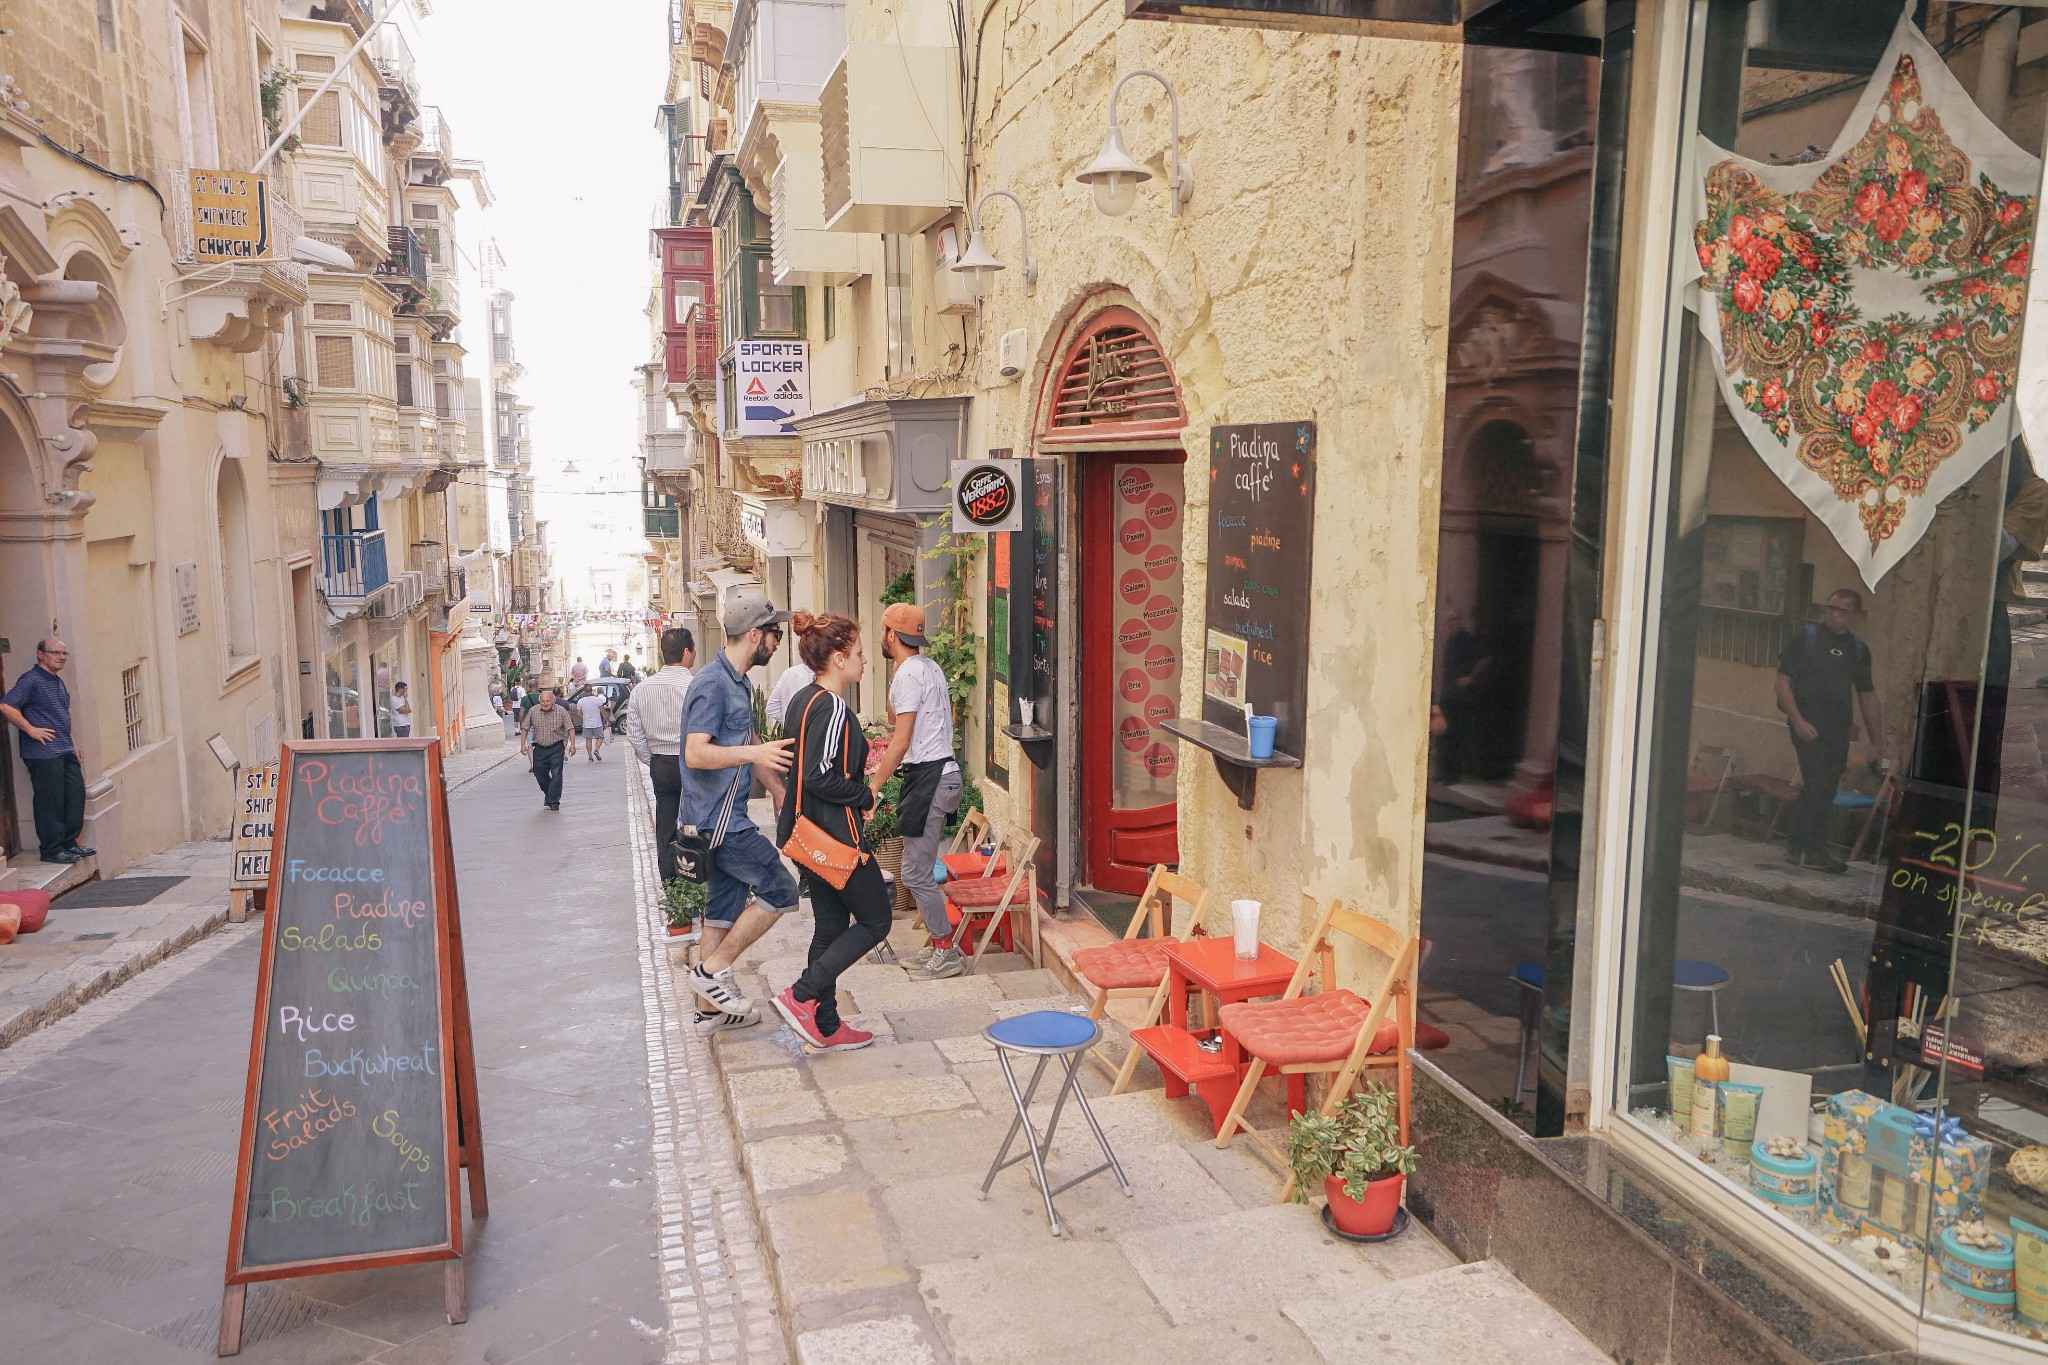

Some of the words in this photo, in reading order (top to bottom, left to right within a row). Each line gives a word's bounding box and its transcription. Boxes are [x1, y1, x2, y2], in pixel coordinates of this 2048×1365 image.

[198, 207, 248, 227] SHIPWRECK
[199, 238, 251, 256] CHURCH
[741, 343, 803, 356] SPORTS
[741, 360, 804, 373] LOCKER
[773, 391, 804, 400] adidas
[1230, 428, 1281, 469] Piadina
[971, 488, 1006, 520] 1882
[1223, 587, 1251, 609] salads
[1142, 605, 1178, 619] Mozzarella
[1252, 643, 1273, 665] rice
[247, 773, 263, 789] ST
[298, 752, 423, 798] Piadina
[287, 858, 386, 884] Focacce
[1891, 868, 1928, 895] on
[335, 886, 427, 929] Piadine
[280, 920, 384, 952] Salads
[279, 1005, 358, 1043] Rice
[303, 1040, 436, 1086] Buckwheat
[263, 1087, 332, 1136] Fruit
[372, 1110, 431, 1173] Soups
[269, 1175, 421, 1226] Breakfast
